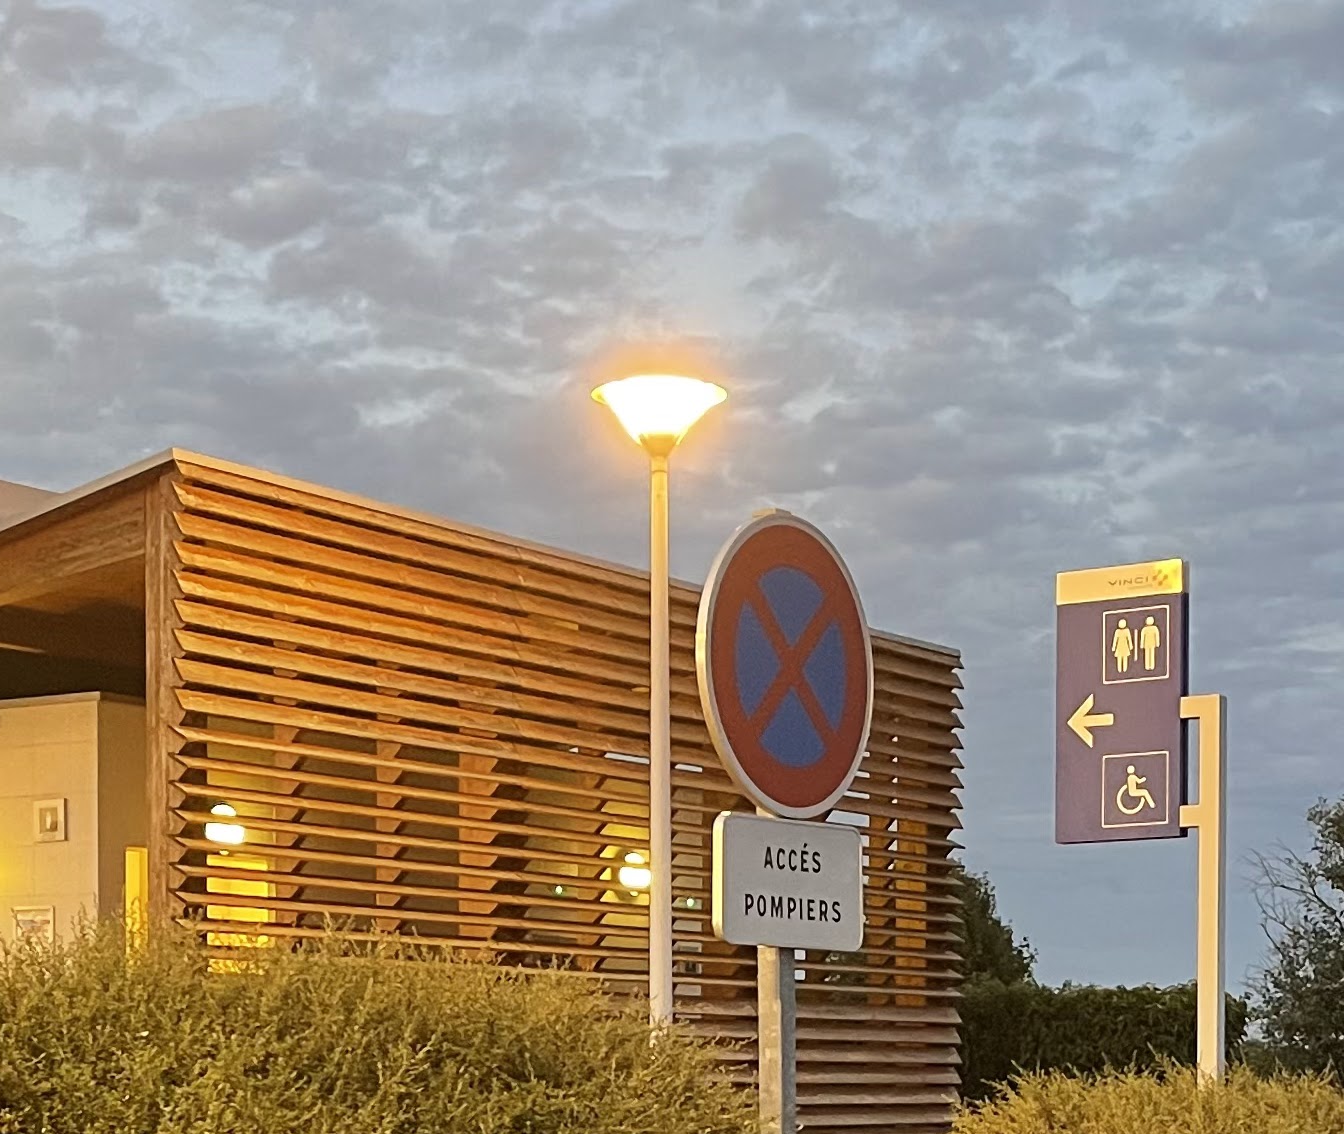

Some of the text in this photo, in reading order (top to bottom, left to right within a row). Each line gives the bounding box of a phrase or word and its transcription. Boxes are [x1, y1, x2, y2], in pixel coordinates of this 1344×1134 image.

[1108, 576, 1149, 586] VINCI
[764, 843, 821, 873] ACCÉS
[744, 893, 841, 923] POMPIERS
